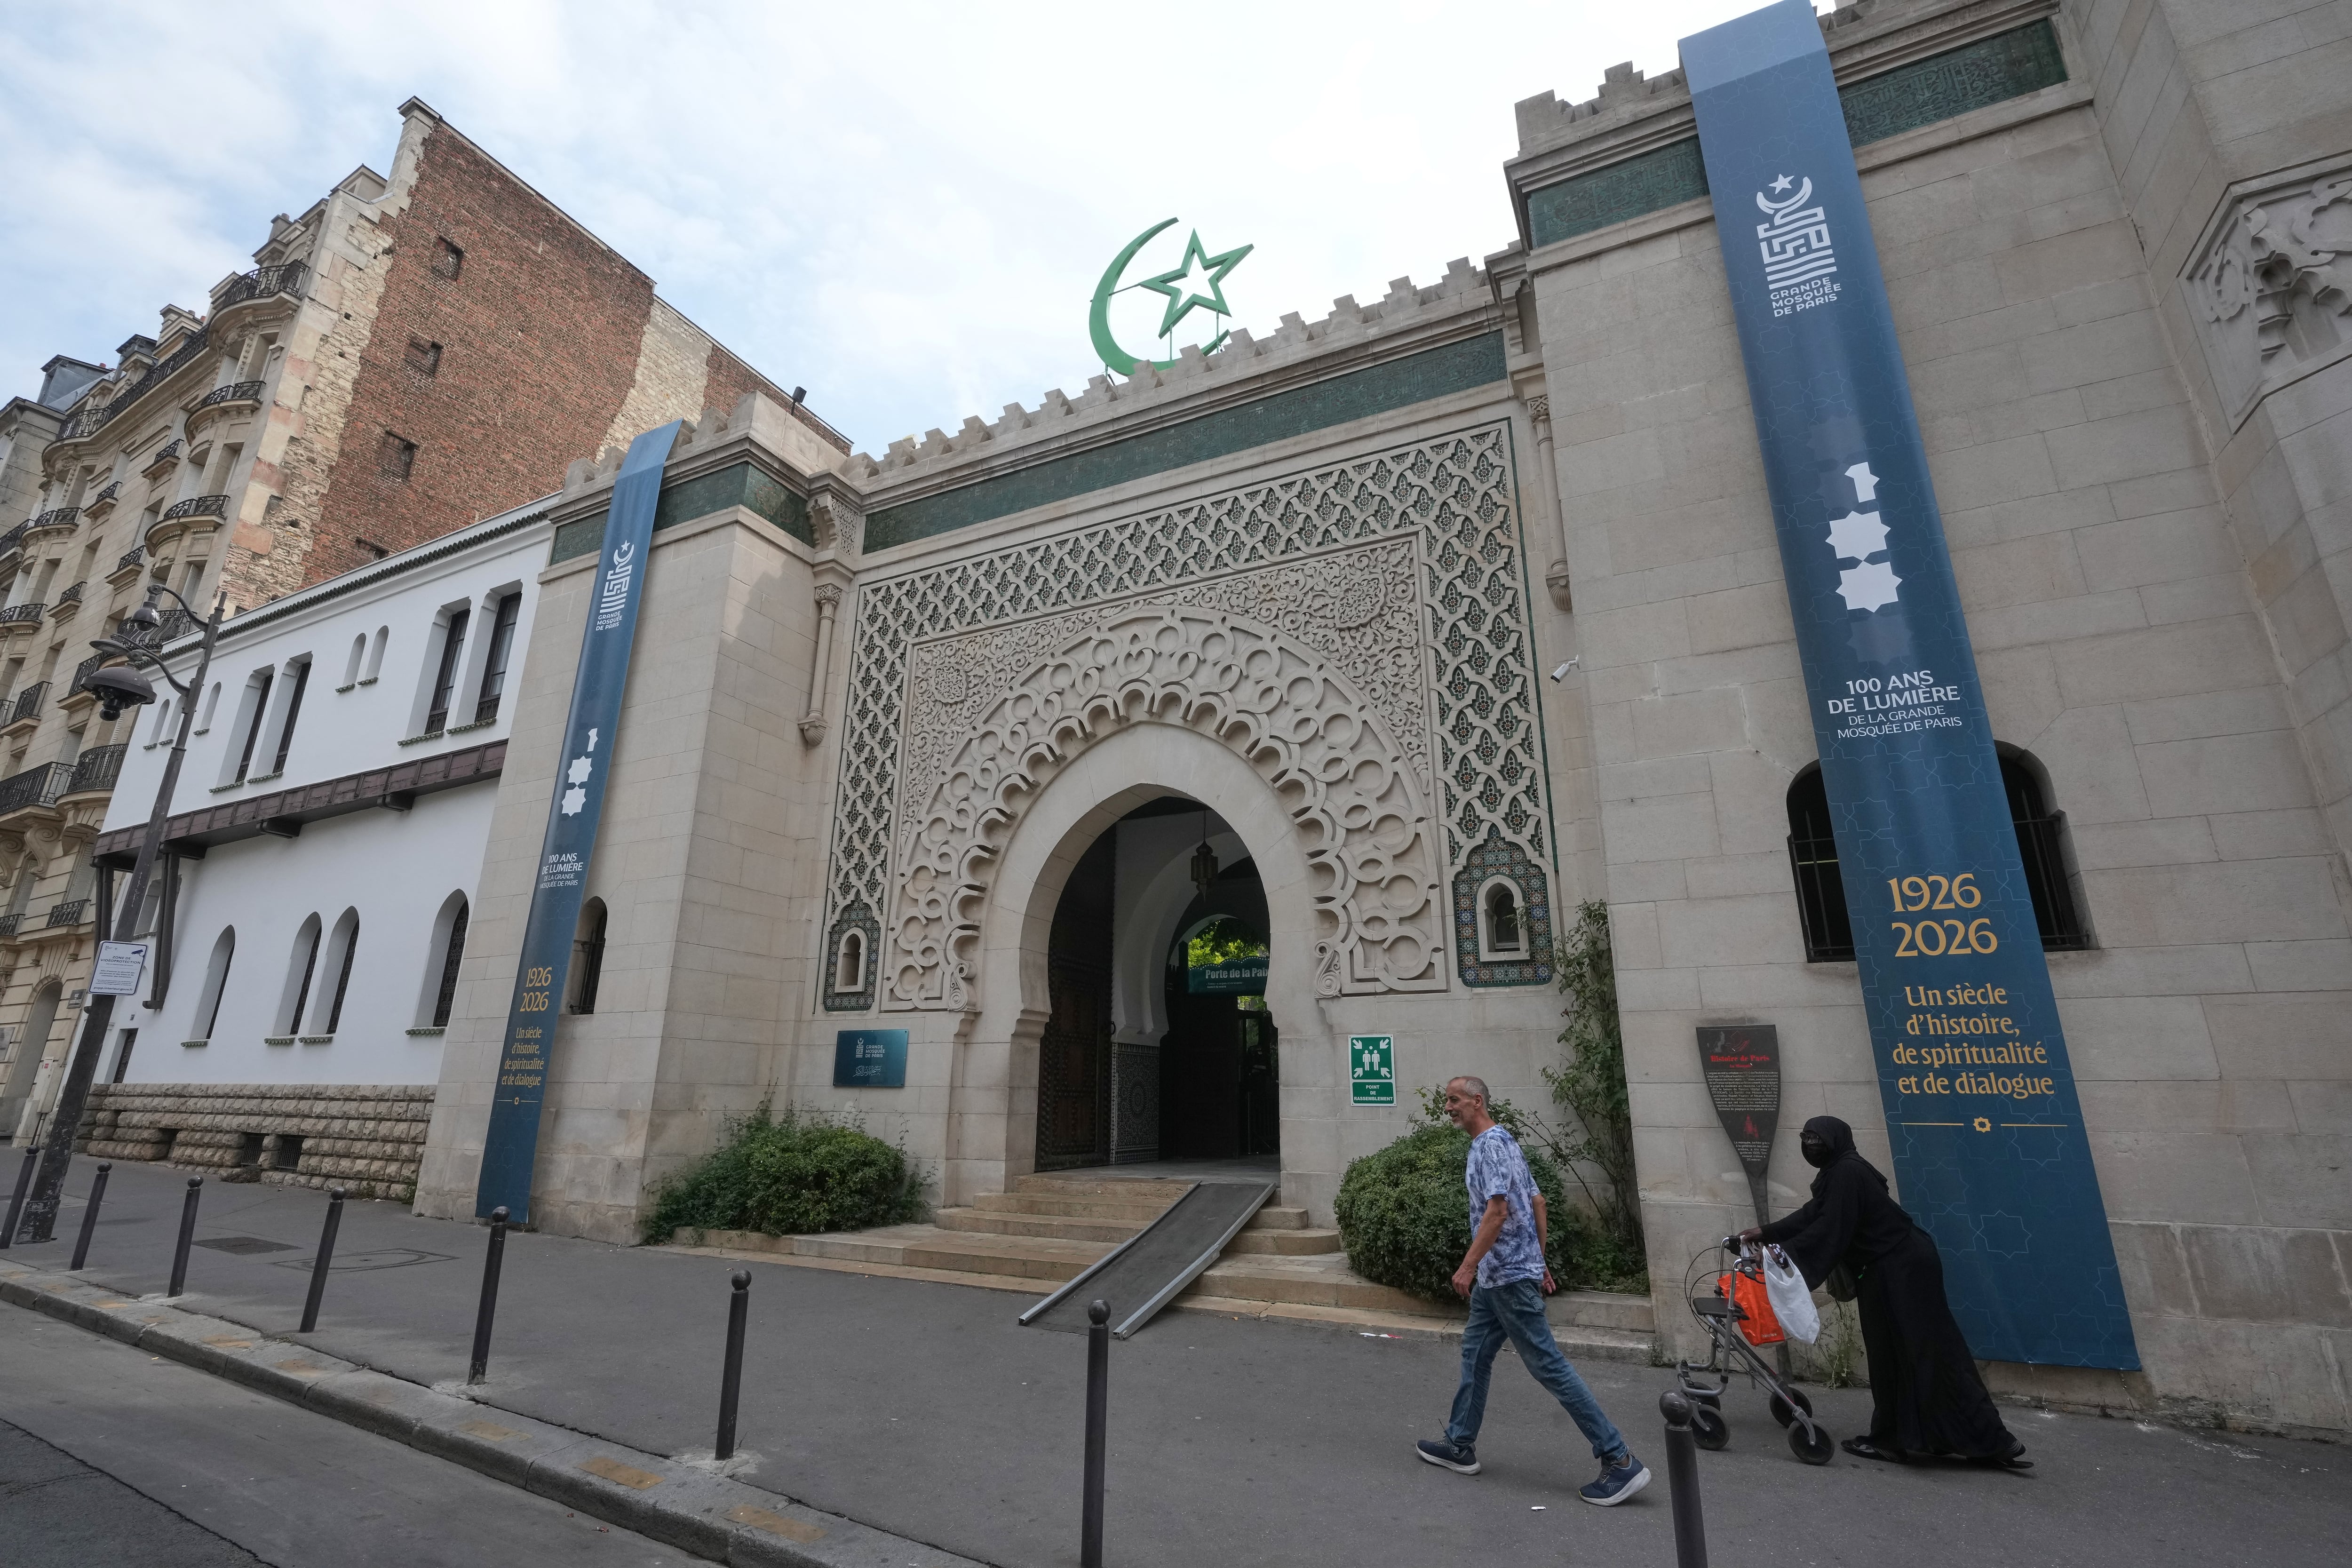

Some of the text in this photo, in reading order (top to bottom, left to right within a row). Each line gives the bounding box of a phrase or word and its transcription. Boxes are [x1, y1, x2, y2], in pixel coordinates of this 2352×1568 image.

[1770, 277, 1831, 300] GRANDE
[1772, 283, 1842, 309] MOSQUÉE
[1774, 293, 1837, 317] DE PARIS
[597, 615, 622, 625] MOSQUÉE
[598, 611, 620, 620] GRANDE
[605, 621, 619, 630] PARIS
[1846, 670, 1934, 695] 100 ANS
[1827, 684, 1960, 714] DE LUMIÈRE
[1848, 705, 1946, 725] DE LA GRANDE
[1837, 716, 1962, 739] MOSQUÉE DE PARIS
[548, 852, 577, 864] 100 ANS
[542, 862, 583, 875] DE LUMIÈRE
[1887, 873, 1981, 912] 1926
[1891, 918, 1998, 957] 2026
[525, 967, 552, 987] 1926
[1206, 970, 1228, 979] Porte
[1230, 969, 1240, 978] de
[1242, 968, 1250, 978] la
[520, 991, 549, 1011] 2026
[1904, 983, 2008, 1006] Un siècle
[516, 1026, 542, 1039] Un siècle
[1906, 1013, 2020, 1036] d'histoire,
[512, 1043, 540, 1055] d'histoire,
[1892, 1041, 2048, 1068] de spiritualité
[504, 1057, 544, 1073] de spiritualité
[501, 1074, 541, 1088] et de dialogue
[1898, 1072, 2055, 1099] et de dialogue
